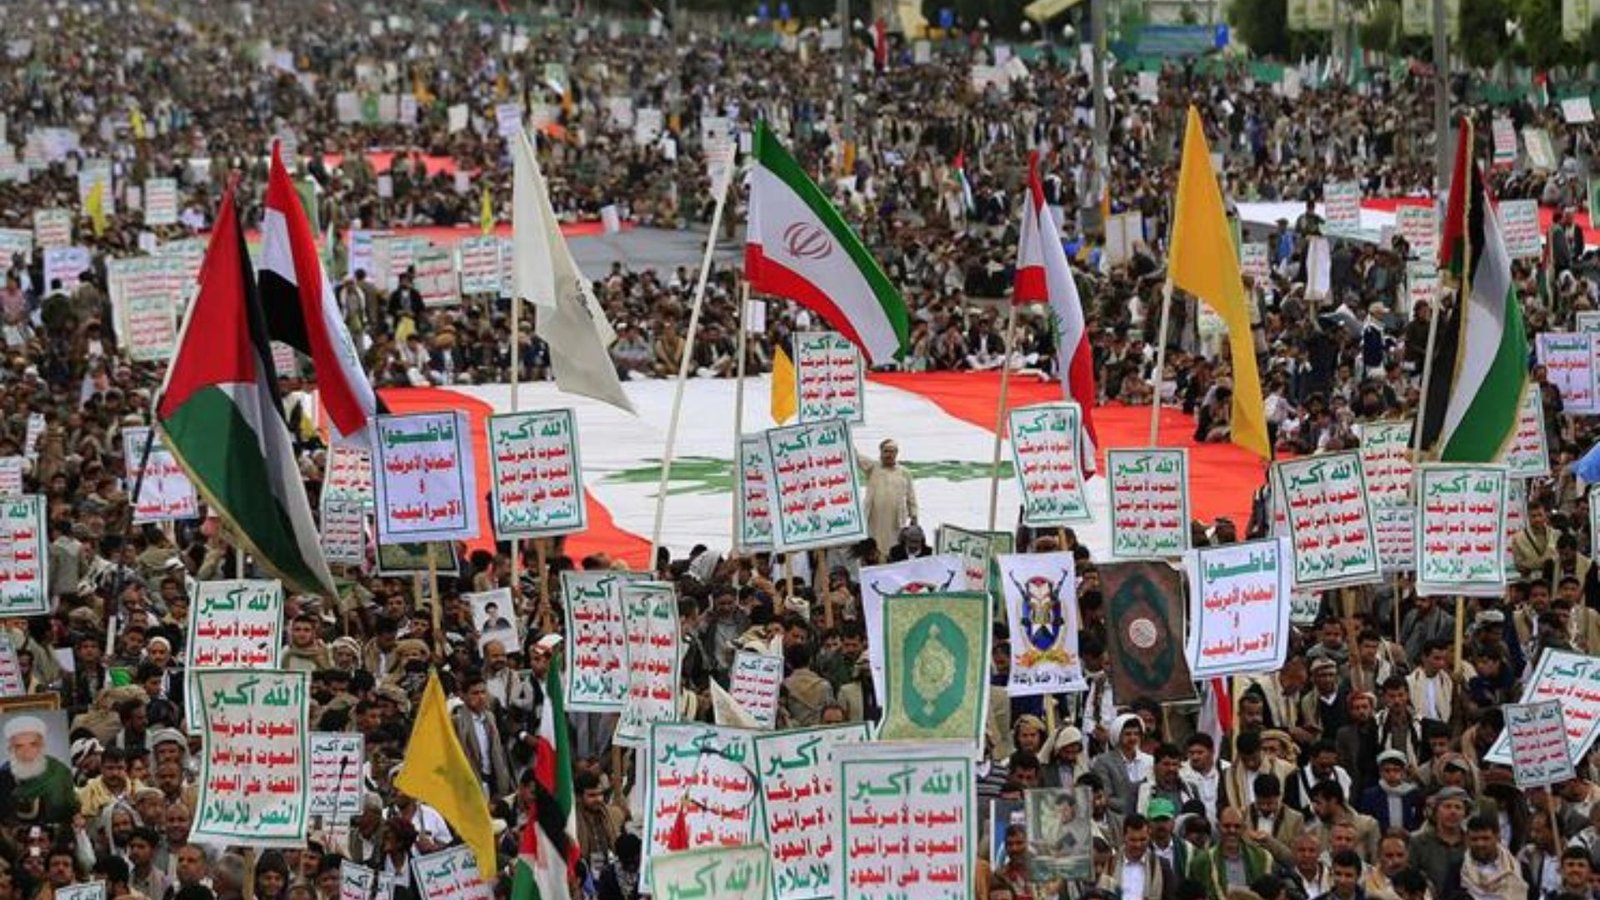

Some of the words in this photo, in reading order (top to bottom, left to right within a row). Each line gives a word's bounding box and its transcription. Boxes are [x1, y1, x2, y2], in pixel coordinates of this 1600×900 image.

[835, 336, 850, 350] لله
[210, 675, 260, 712] أكبر
[262, 680, 299, 706] الله
[211, 715, 252, 738] لأمريكا
[257, 718, 299, 739] الموت
[212, 745, 252, 765] لإسرائيل
[256, 747, 299, 765] الموت
[765, 736, 823, 778] أكبر
[208, 774, 240, 796] اليهود
[244, 774, 262, 796] على
[266, 775, 299, 794] اللعنة
[766, 774, 820, 800] لأمريكا
[850, 765, 917, 803] أكبر
[922, 768, 962, 794] الله
[204, 800, 250, 830] للإسلام
[257, 800, 297, 830] النصر
[771, 807, 824, 833] لإسرائيل
[850, 803, 909, 828] لأمريكا
[915, 806, 962, 828] الموت
[774, 839, 812, 862] اليهود
[816, 834, 832, 858] لى
[850, 835, 909, 859] لإسرائيل
[915, 836, 962, 857] الموت
[778, 862, 830, 895] للإسلام
[850, 865, 891, 888] اليهود
[898, 865, 920, 887] على
[928, 863, 962, 883] اللعنة
